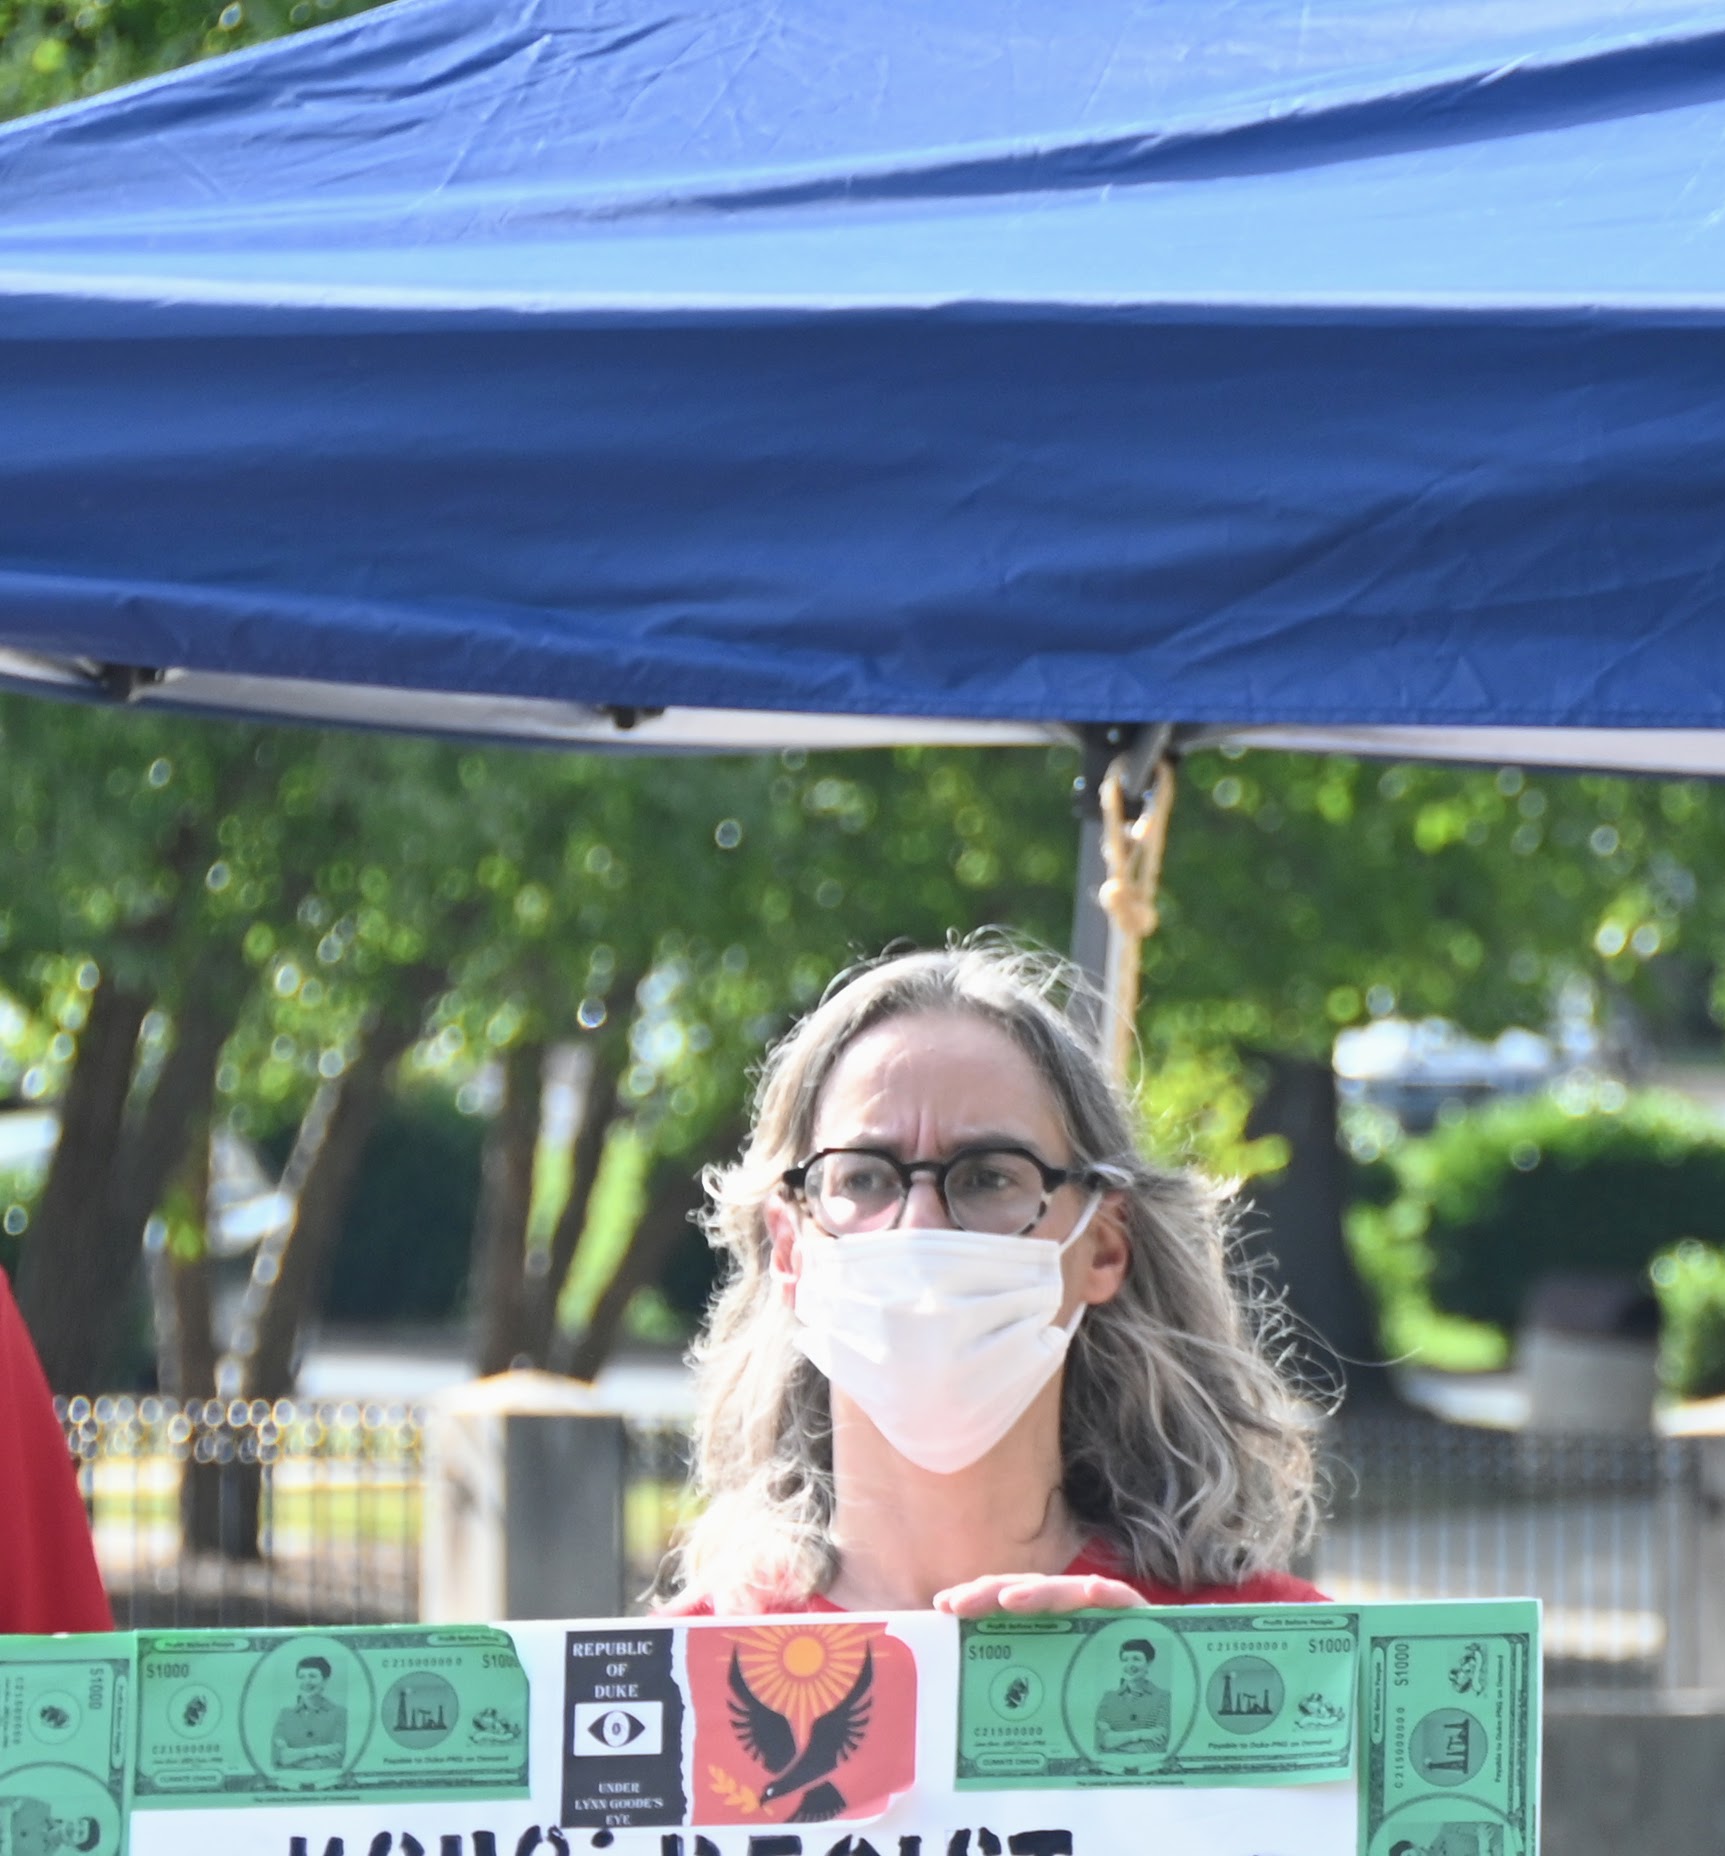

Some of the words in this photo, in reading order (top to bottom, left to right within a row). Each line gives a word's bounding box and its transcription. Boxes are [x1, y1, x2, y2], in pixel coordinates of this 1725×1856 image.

[573, 1641, 653, 1657] REPUBLIC
[606, 1663, 628, 1677] OF
[594, 1683, 639, 1699] DUKE
[598, 1782, 640, 1794] UNDER
[605, 1813, 631, 1826] EYE
